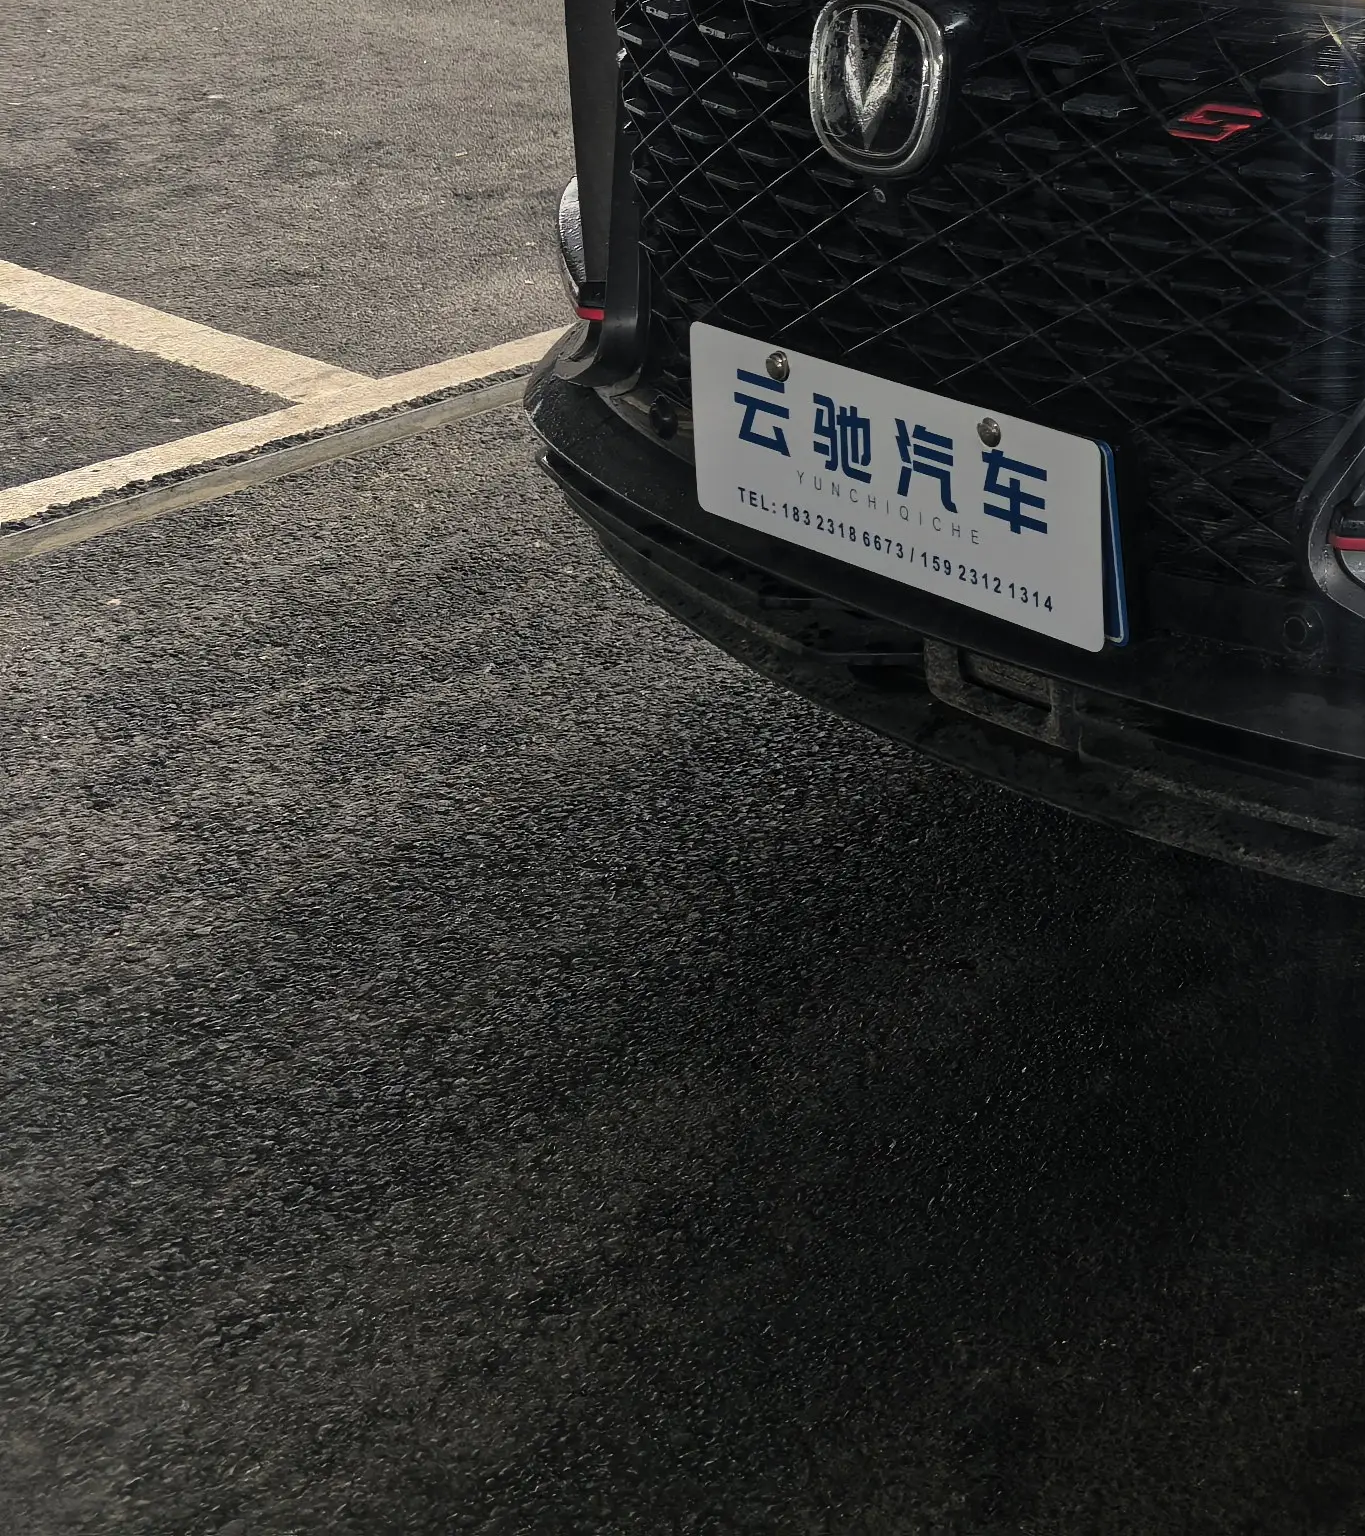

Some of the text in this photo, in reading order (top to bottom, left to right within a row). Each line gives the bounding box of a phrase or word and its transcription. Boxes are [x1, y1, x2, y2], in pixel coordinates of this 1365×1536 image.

[733, 368, 1049, 535] 云驰汽车
[796, 470, 981, 546] YUNCHIQICHE
